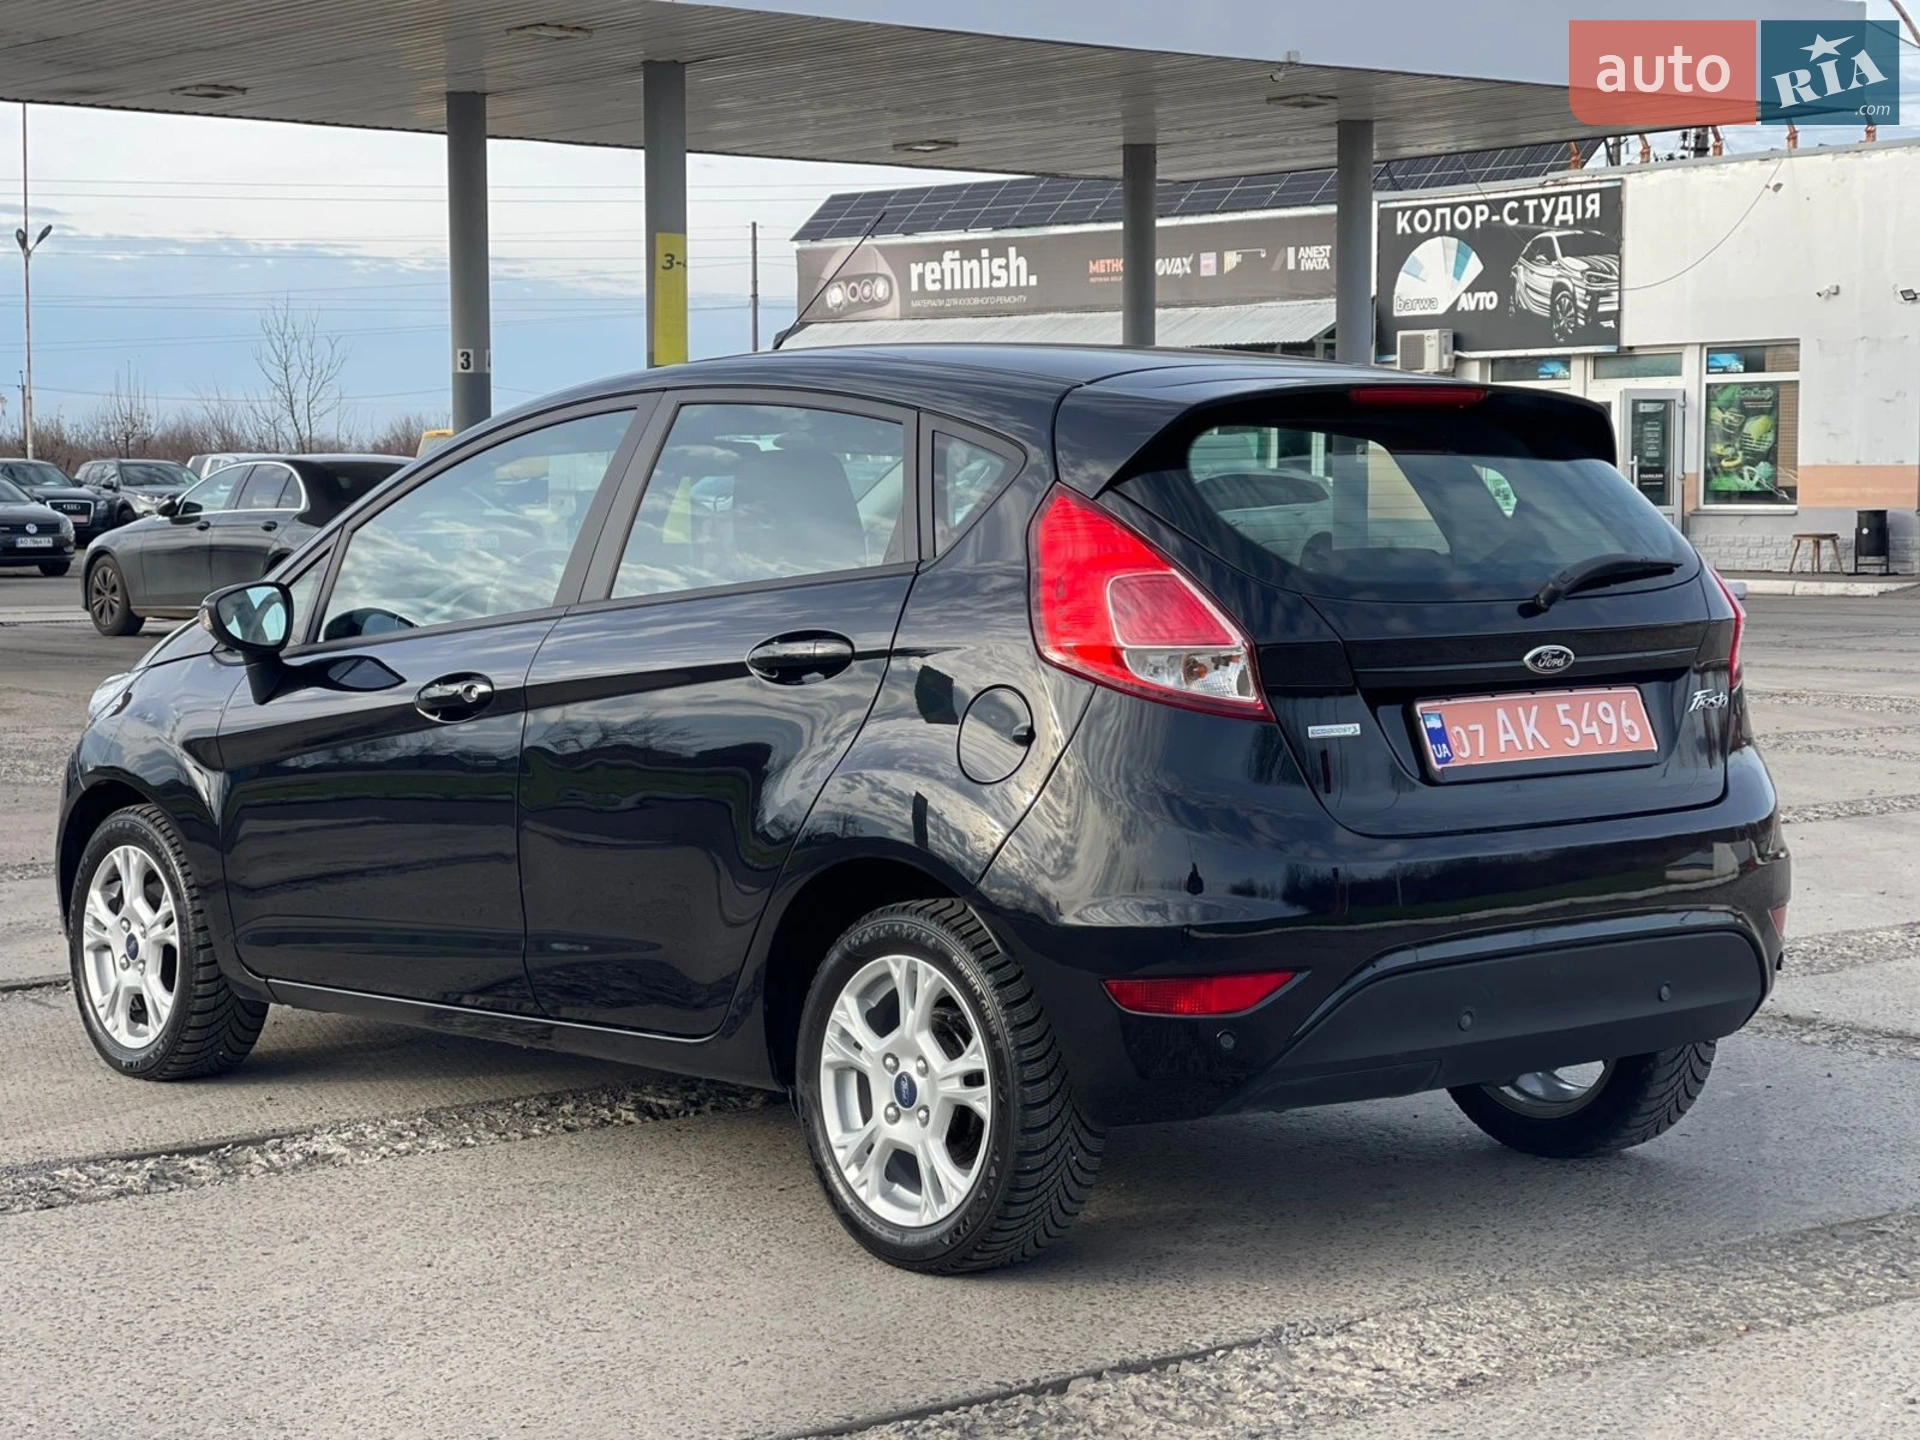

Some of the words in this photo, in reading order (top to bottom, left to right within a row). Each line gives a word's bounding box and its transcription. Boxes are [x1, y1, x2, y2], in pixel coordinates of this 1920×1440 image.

[1396, 192, 1601, 235] КОЛОР-СТУДІЯ
[1297, 244, 1332, 260] ANEST
[910, 246, 1038, 292] refinish.
[1300, 257, 1331, 271] IWATA
[1395, 295, 1439, 312] barwa
[459, 351, 472, 371] 3
[1537, 648, 1567, 667] Ford
[1688, 688, 1729, 713] Fiesta
[1453, 723, 1487, 760] 07
[1497, 705, 1550, 755] AK
[1555, 699, 1643, 748] 5496
[1431, 742, 1452, 759] UA
